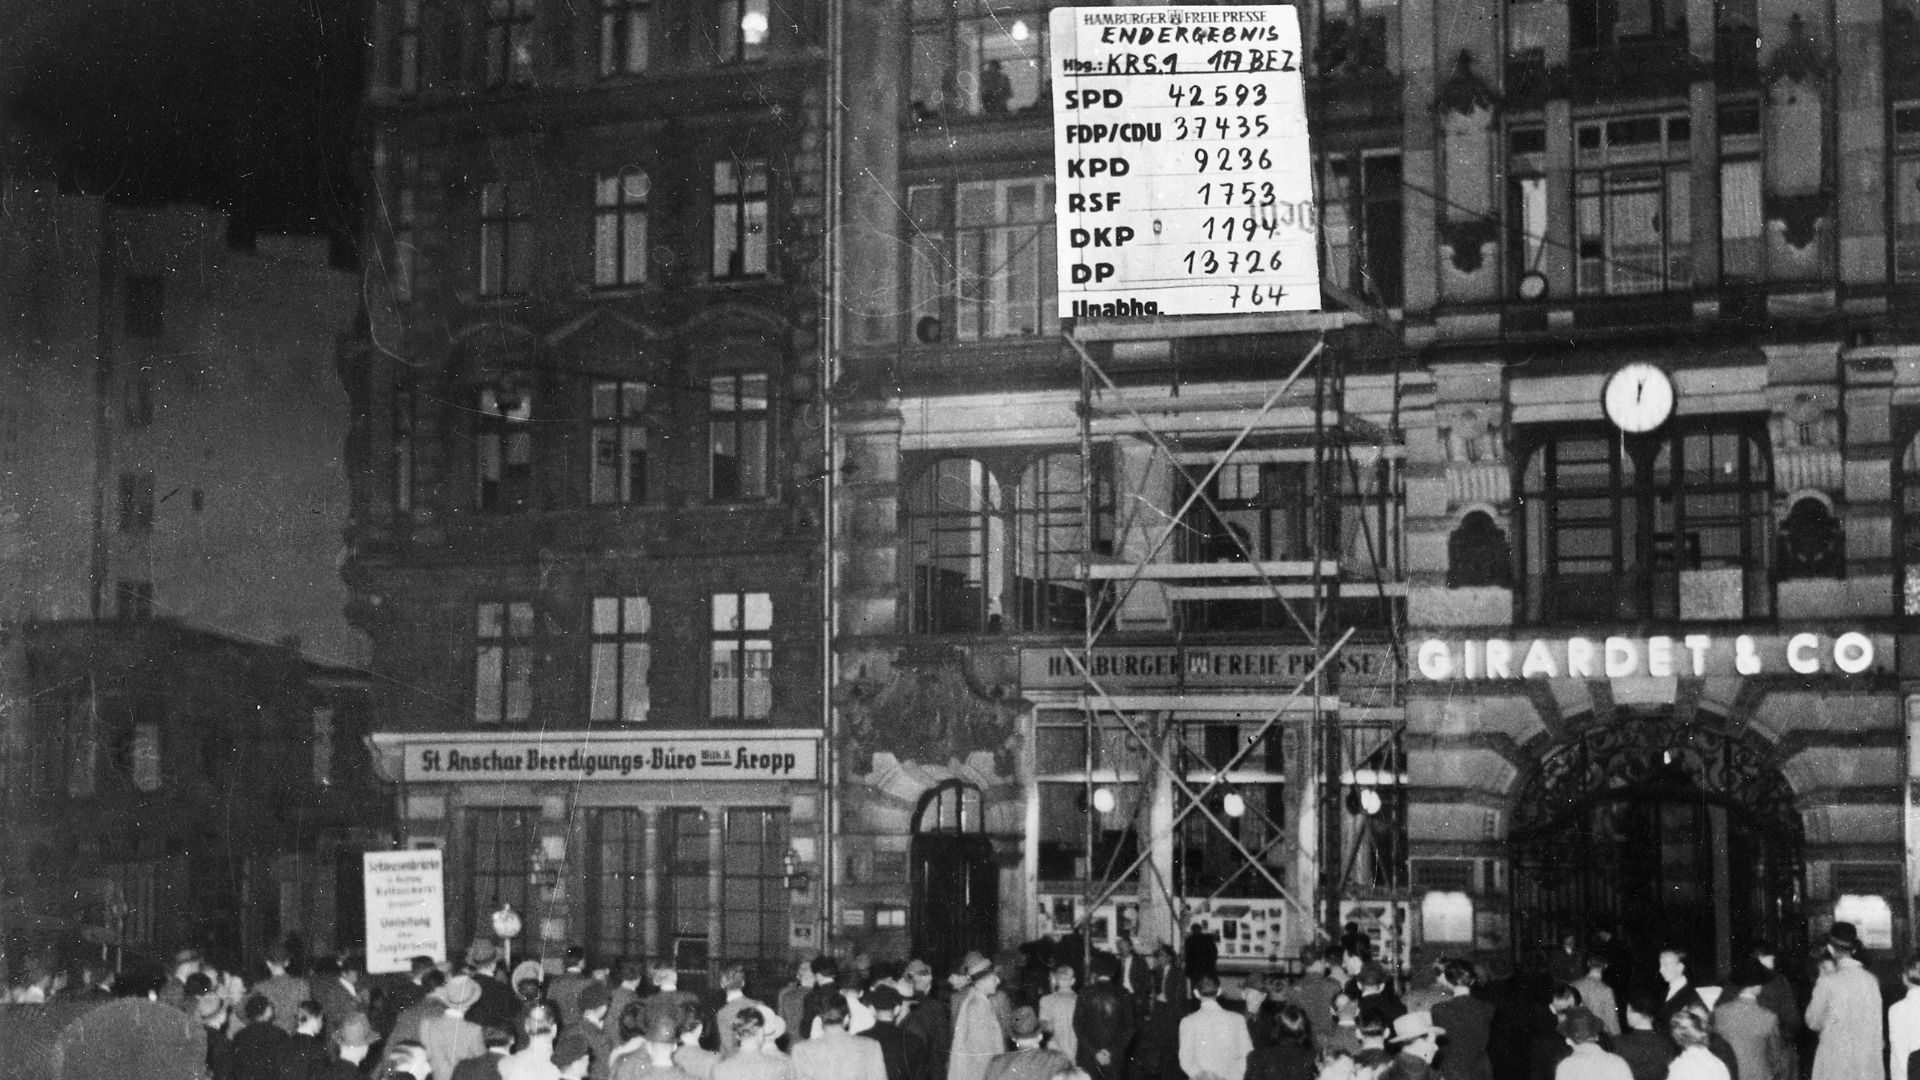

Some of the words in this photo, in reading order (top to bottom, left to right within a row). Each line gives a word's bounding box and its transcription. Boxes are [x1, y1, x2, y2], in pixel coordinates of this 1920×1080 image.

[1084, 12, 1167, 26] HAMBURGER
[1184, 11, 1220, 24] FREIE
[1222, 11, 1267, 23] PRESSE
[1101, 25, 1279, 46] ENDERGEBNIS
[1248, 49, 1296, 73] BEZ
[1065, 89, 1123, 109] SPD
[1169, 83, 1267, 107] 42593
[1066, 122, 1161, 143] FDP/CDU
[1174, 115, 1270, 140] 37435
[1068, 157, 1130, 178] KPD
[1194, 148, 1272, 173] 9236
[1069, 192, 1121, 212] RSF
[1198, 182, 1276, 205] 1753
[1070, 226, 1134, 248] DKP
[1203, 217, 1278, 241] 1194
[1071, 263, 1115, 284] DP
[1183, 250, 1282, 274] 13726
[1228, 285, 1287, 308] 764
[1214, 654, 1280, 675] FREIE
[1418, 635, 1710, 680] GIRARDET
[1736, 635, 1762, 676] &
[1787, 632, 1874, 675] CO
[447, 749, 523, 772] Anschar
[734, 746, 796, 775] Kropp
